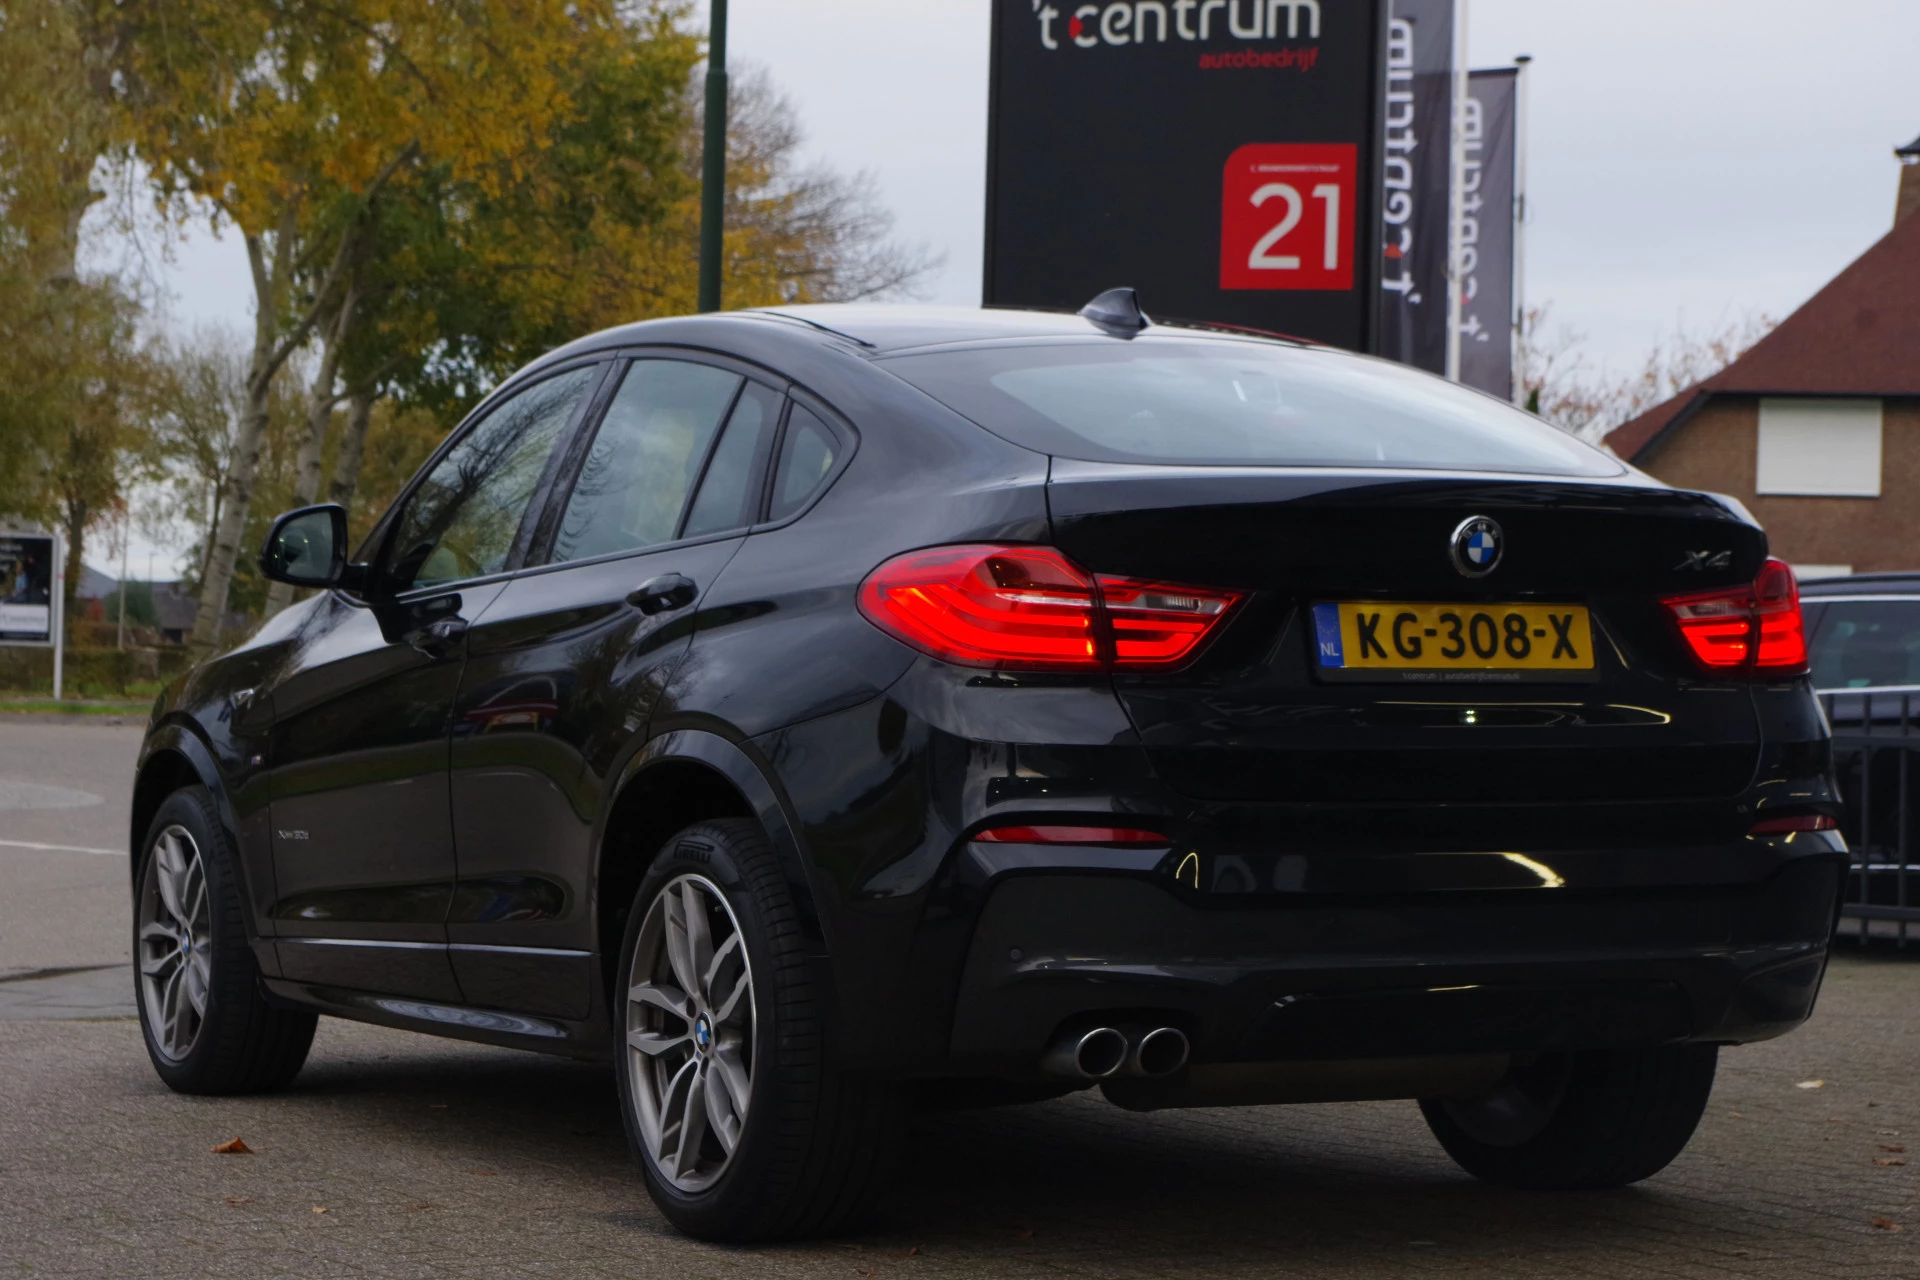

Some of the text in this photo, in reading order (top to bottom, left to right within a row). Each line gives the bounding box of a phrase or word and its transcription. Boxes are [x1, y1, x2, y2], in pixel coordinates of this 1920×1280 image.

[1032, 0, 1320, 50] 't centrum
[1199, 46, 1319, 72] autobedrijf
[1248, 183, 1340, 269] 21
[1672, 550, 1733, 571] X4
[1320, 642, 1340, 656] NL
[1356, 612, 1579, 660] KG-308-X
